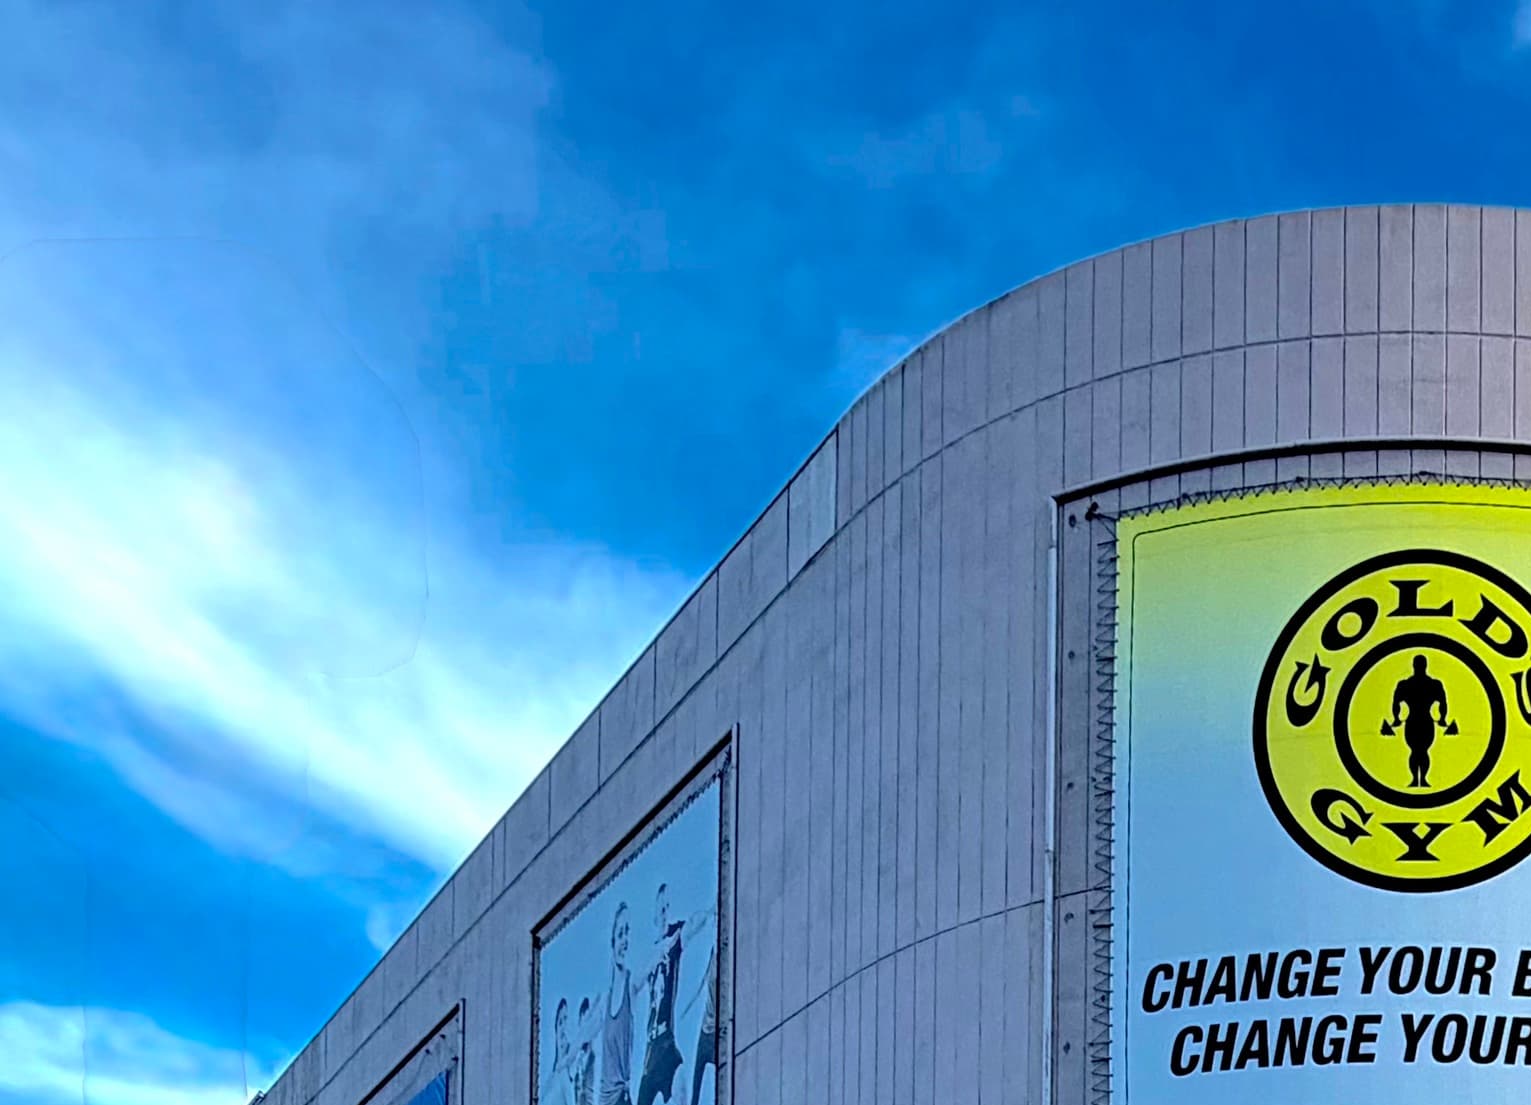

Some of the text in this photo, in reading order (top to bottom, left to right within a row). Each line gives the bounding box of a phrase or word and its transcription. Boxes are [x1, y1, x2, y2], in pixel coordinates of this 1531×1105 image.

[1142, 948, 1346, 1013] CHANGE
[1358, 945, 1497, 995] YOUR
[1170, 1014, 1383, 1077] CHANGE
